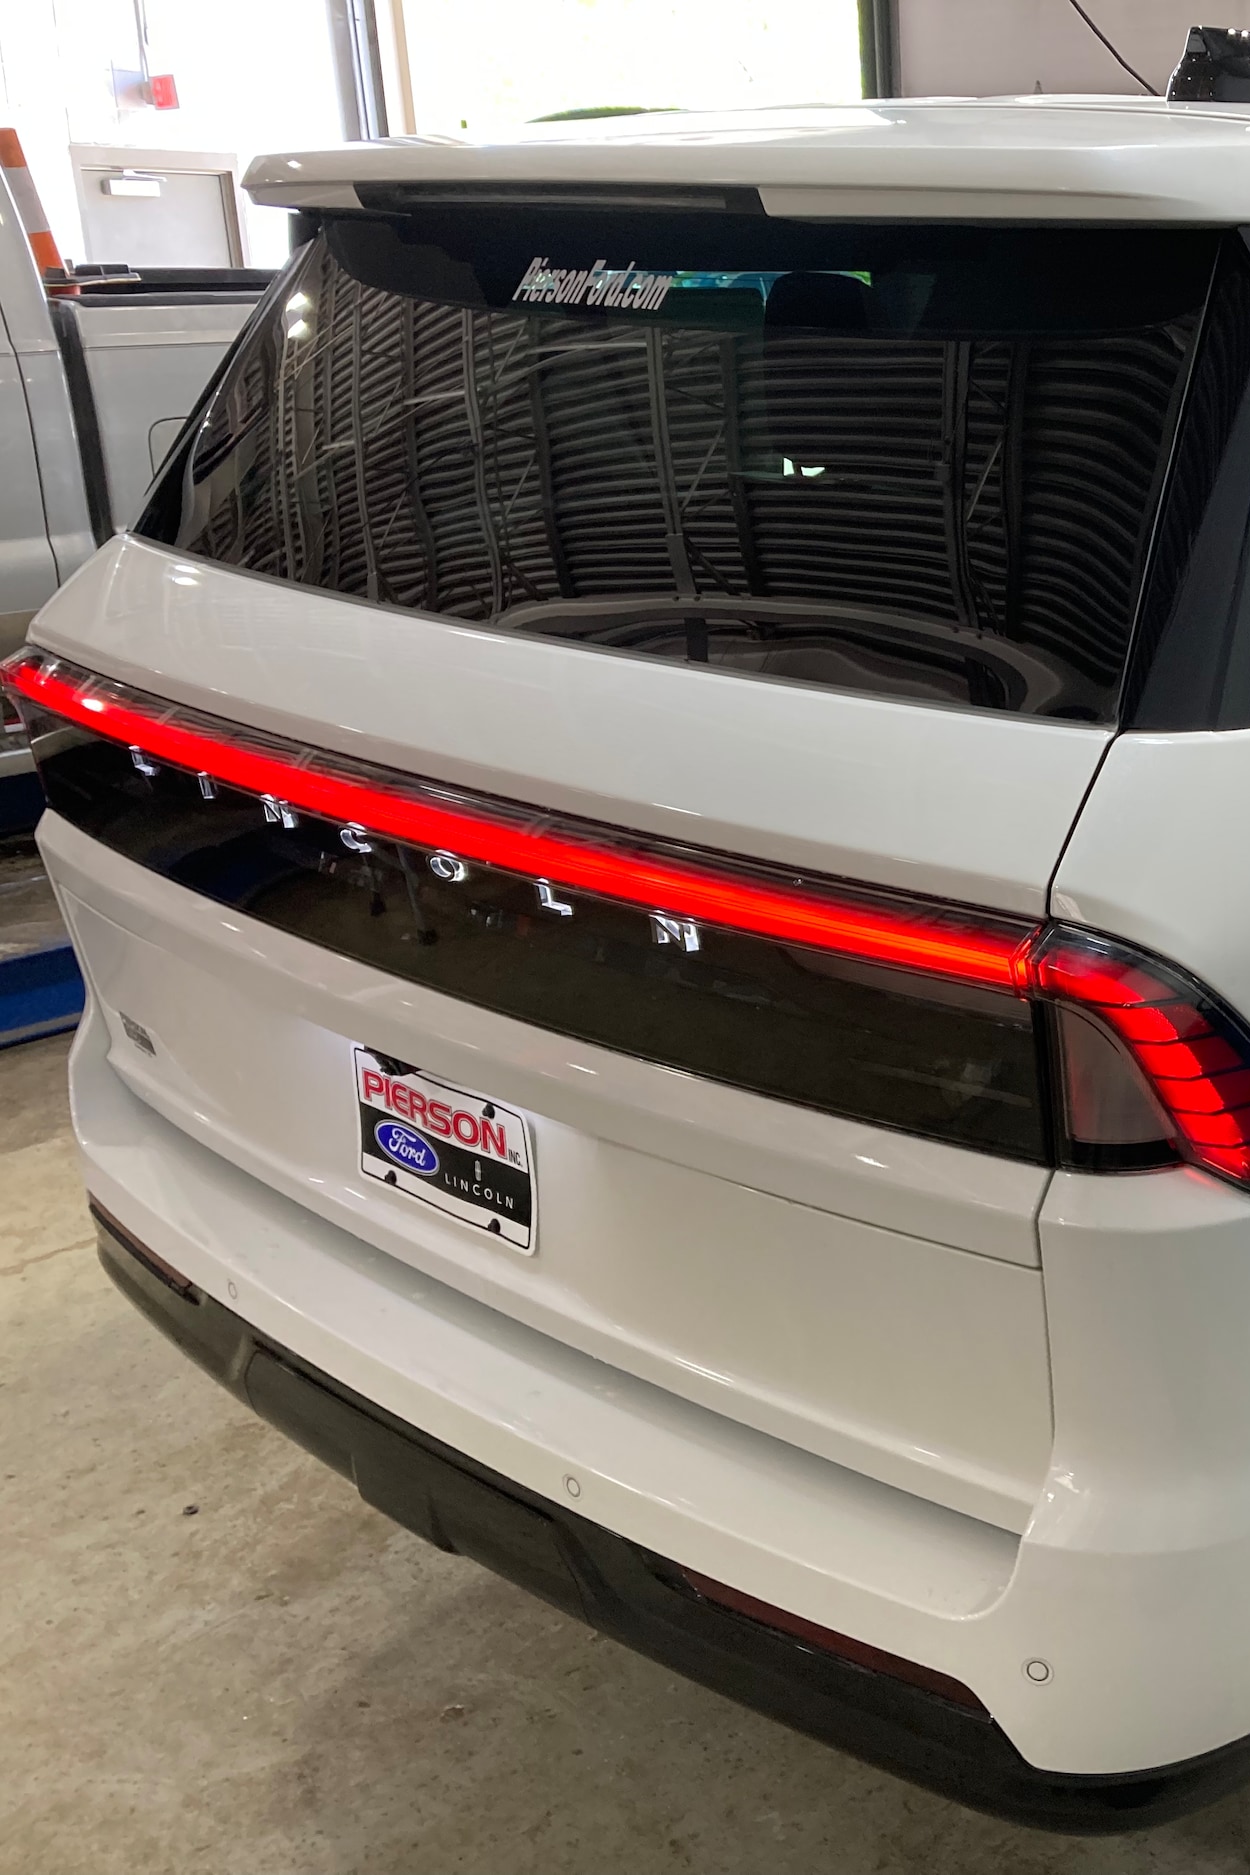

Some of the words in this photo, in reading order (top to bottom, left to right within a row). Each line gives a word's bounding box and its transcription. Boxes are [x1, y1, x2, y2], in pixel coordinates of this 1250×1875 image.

[512, 257, 672, 310] PiersonFord.com
[128, 744, 701, 952] LINCOLN
[362, 1068, 508, 1160] PIERSON
[388, 1127, 427, 1167] Ford
[444, 1173, 514, 1209] LINCOLN
